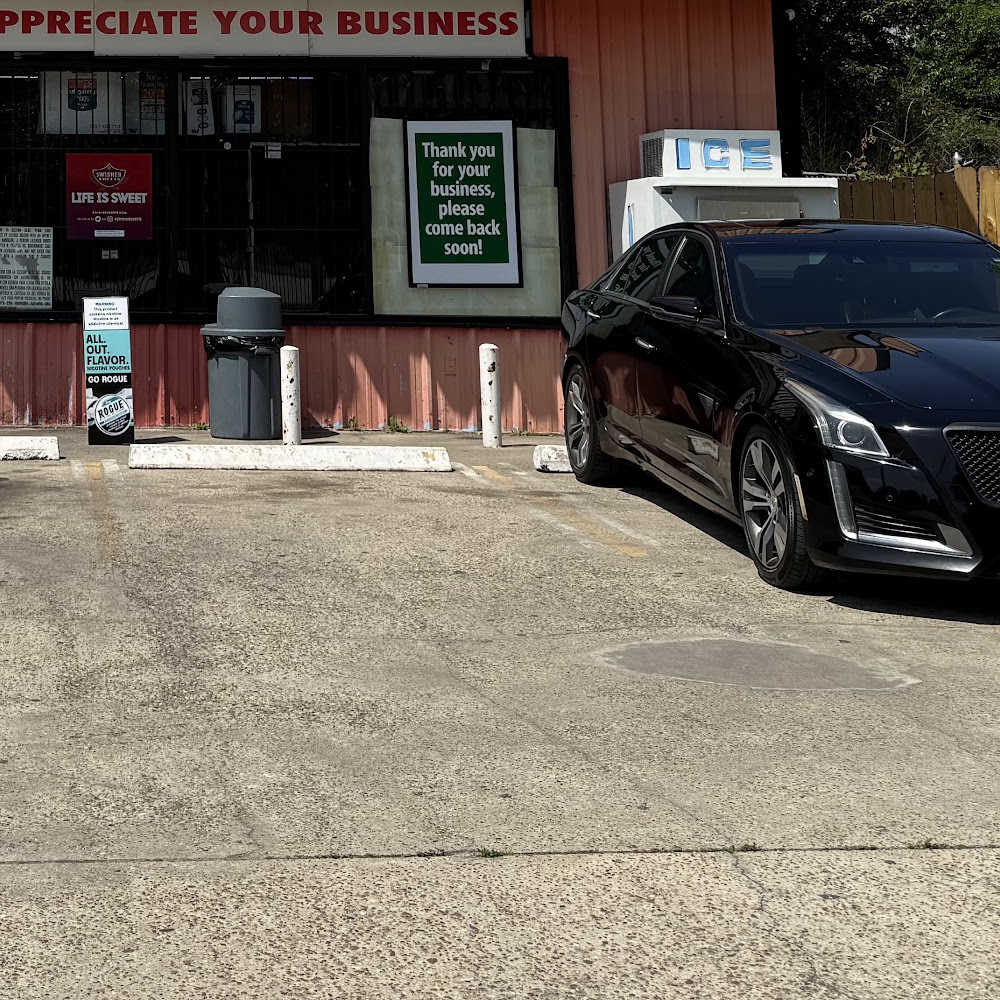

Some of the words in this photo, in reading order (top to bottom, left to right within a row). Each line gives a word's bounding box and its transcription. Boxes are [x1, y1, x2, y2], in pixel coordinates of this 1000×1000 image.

[213, 10, 324, 35] YOUR
[336, 10, 519, 35] BUSINESS
[422, 141, 467, 158] Thank
[469, 145, 496, 162] you
[674, 137, 774, 172] ICE
[431, 160, 454, 177] for
[457, 164, 491, 181] your
[71, 192, 95, 204] LIFE
[96, 192, 110, 204] IS
[111, 192, 148, 204] SWEET
[430, 180, 496, 199] business,
[438, 199, 485, 220] please
[425, 222, 464, 236] come
[466, 219, 501, 236] back
[444, 239, 483, 255] soon!
[86, 334, 106, 344] ALL.
[86, 345, 110, 354] OUT.
[87, 355, 129, 366] FLAVOR.
[88, 375, 100, 384] GO
[101, 375, 128, 383] ROGUE
[97, 399, 124, 419] ROGUE
